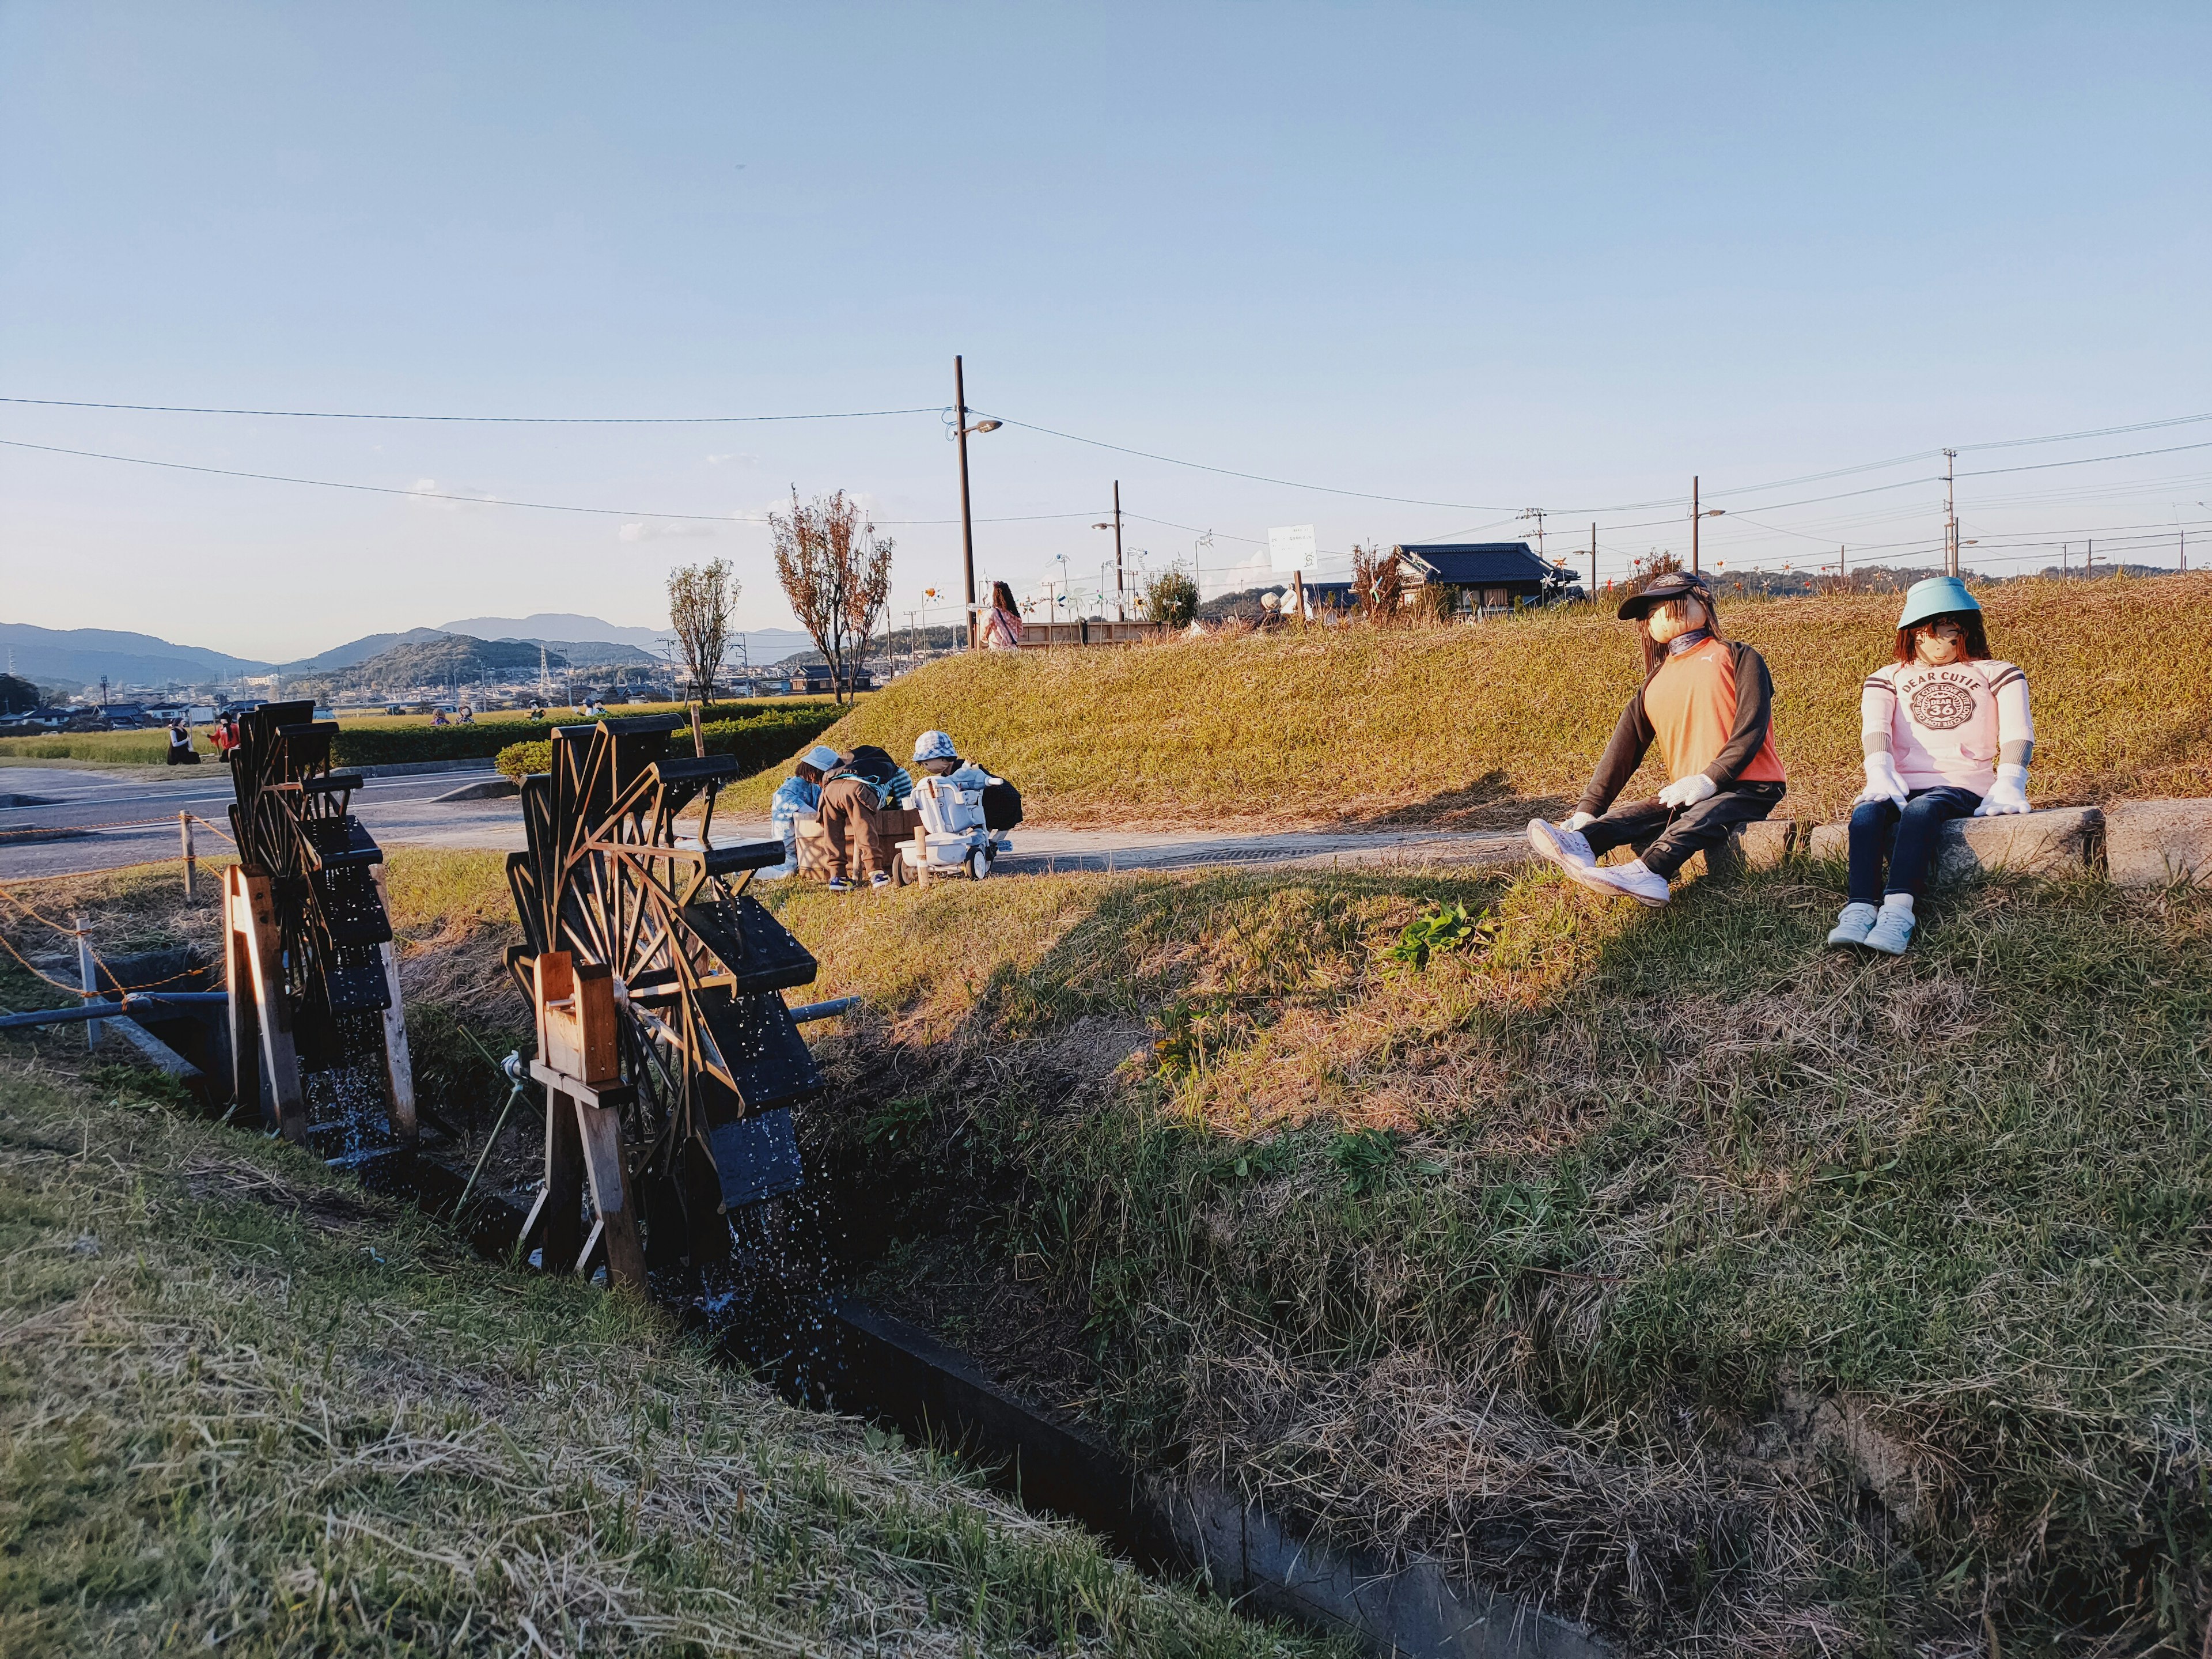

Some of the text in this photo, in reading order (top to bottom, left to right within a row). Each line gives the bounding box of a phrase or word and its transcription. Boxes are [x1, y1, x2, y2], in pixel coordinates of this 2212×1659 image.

[1902, 672, 1981, 693] DEAR CUTIE
[1922, 685, 1941, 696] CUTE
[1941, 685, 1960, 694] LOVE
[1958, 692, 1971, 705] CUTE
[1914, 706, 1925, 720] CUTE
[1929, 704, 1954, 715] 36
[1959, 706, 1971, 719] LOVE
[1923, 718, 1941, 727] LOVE
[1942, 718, 1961, 727] CUTE
